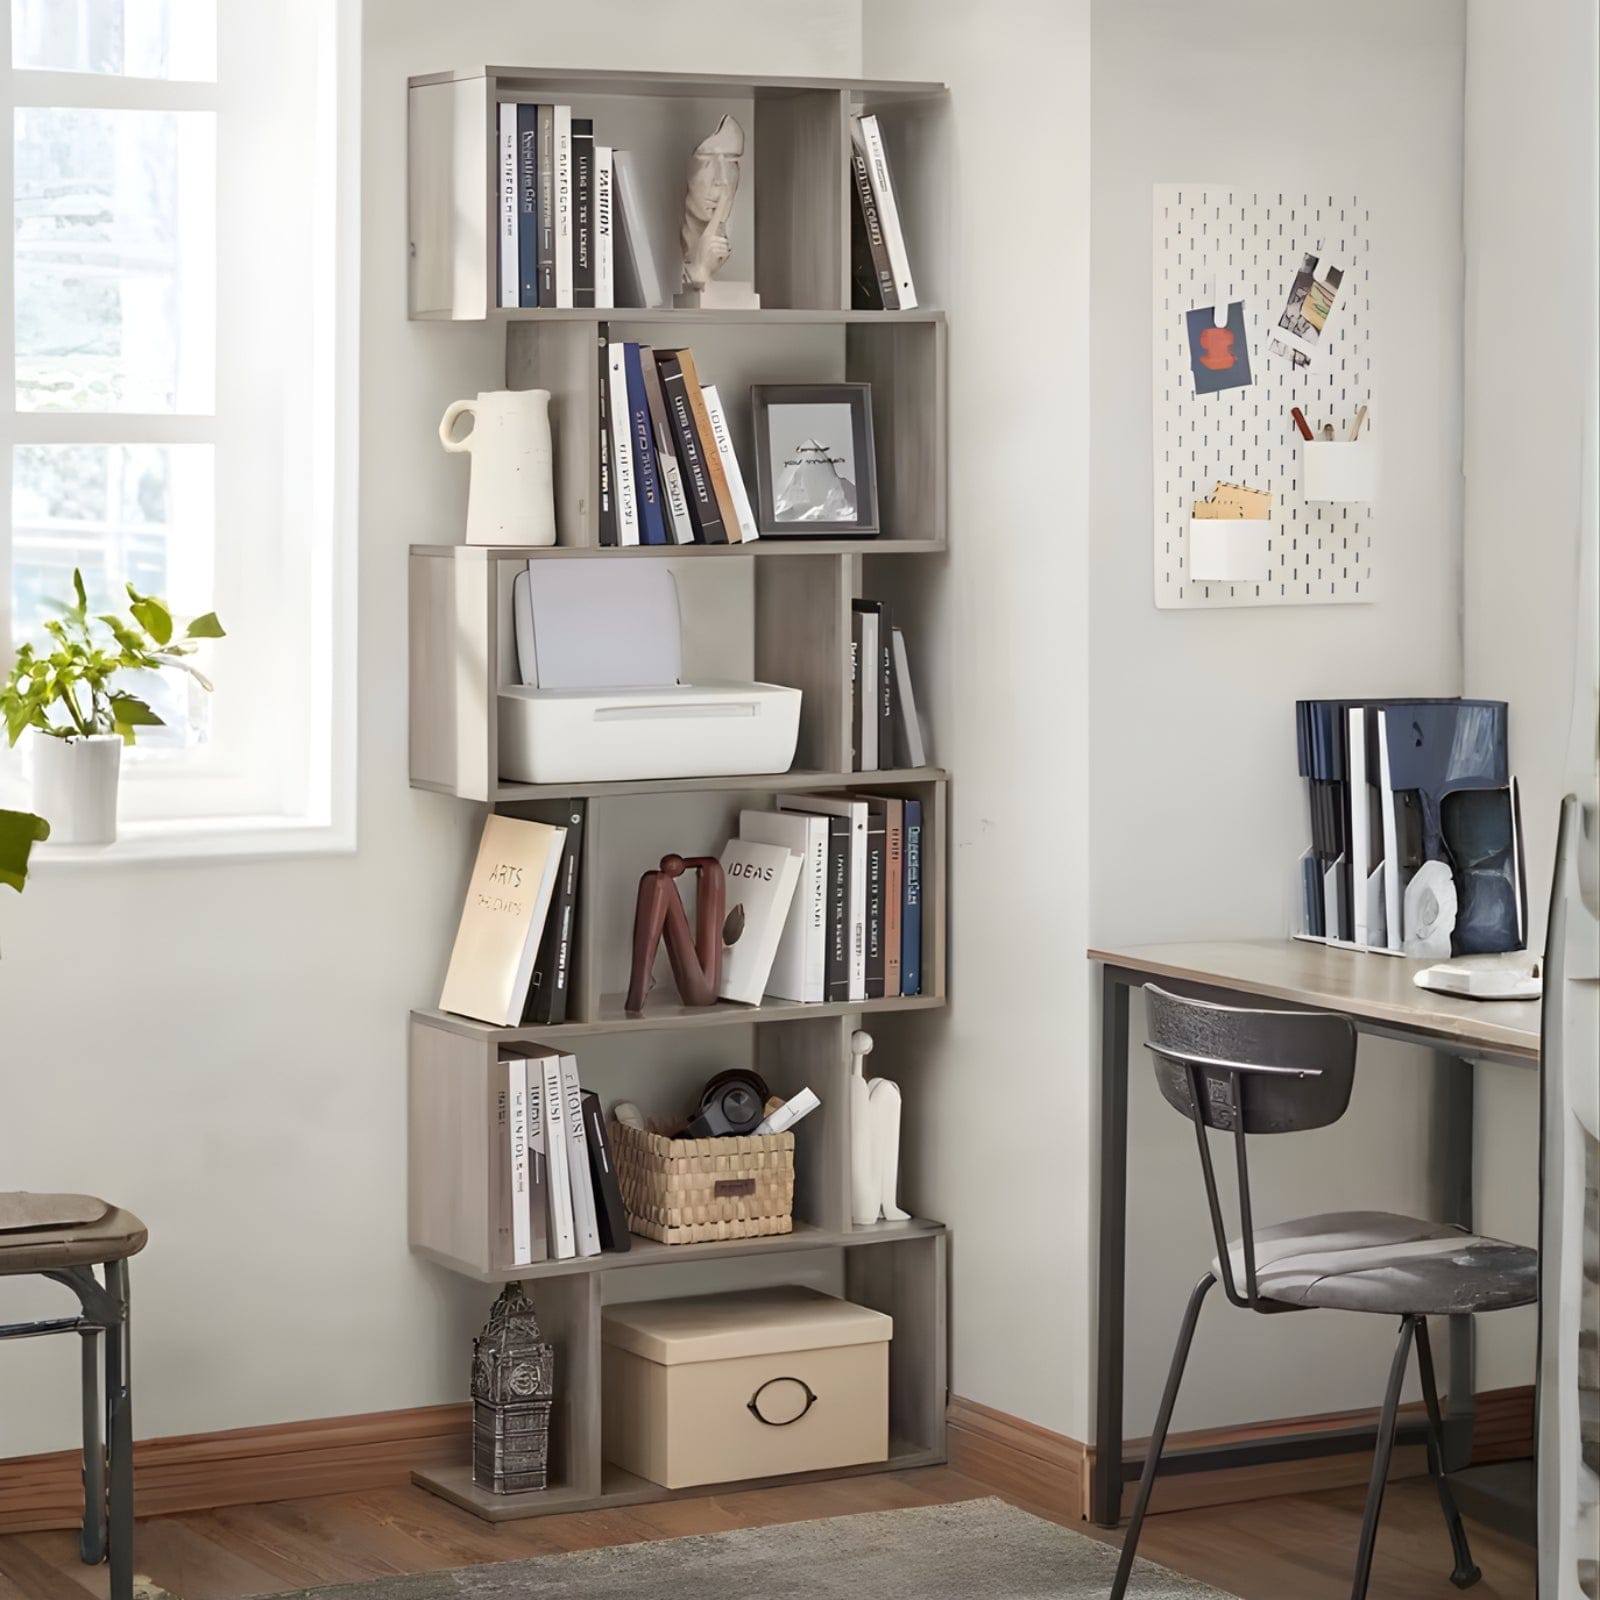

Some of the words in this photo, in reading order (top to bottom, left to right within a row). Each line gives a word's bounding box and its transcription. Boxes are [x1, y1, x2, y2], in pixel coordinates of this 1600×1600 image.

[489, 864, 523, 888] ARTS
[728, 863, 774, 881] IDEAS
[566, 1084, 585, 1143] HOUSE
